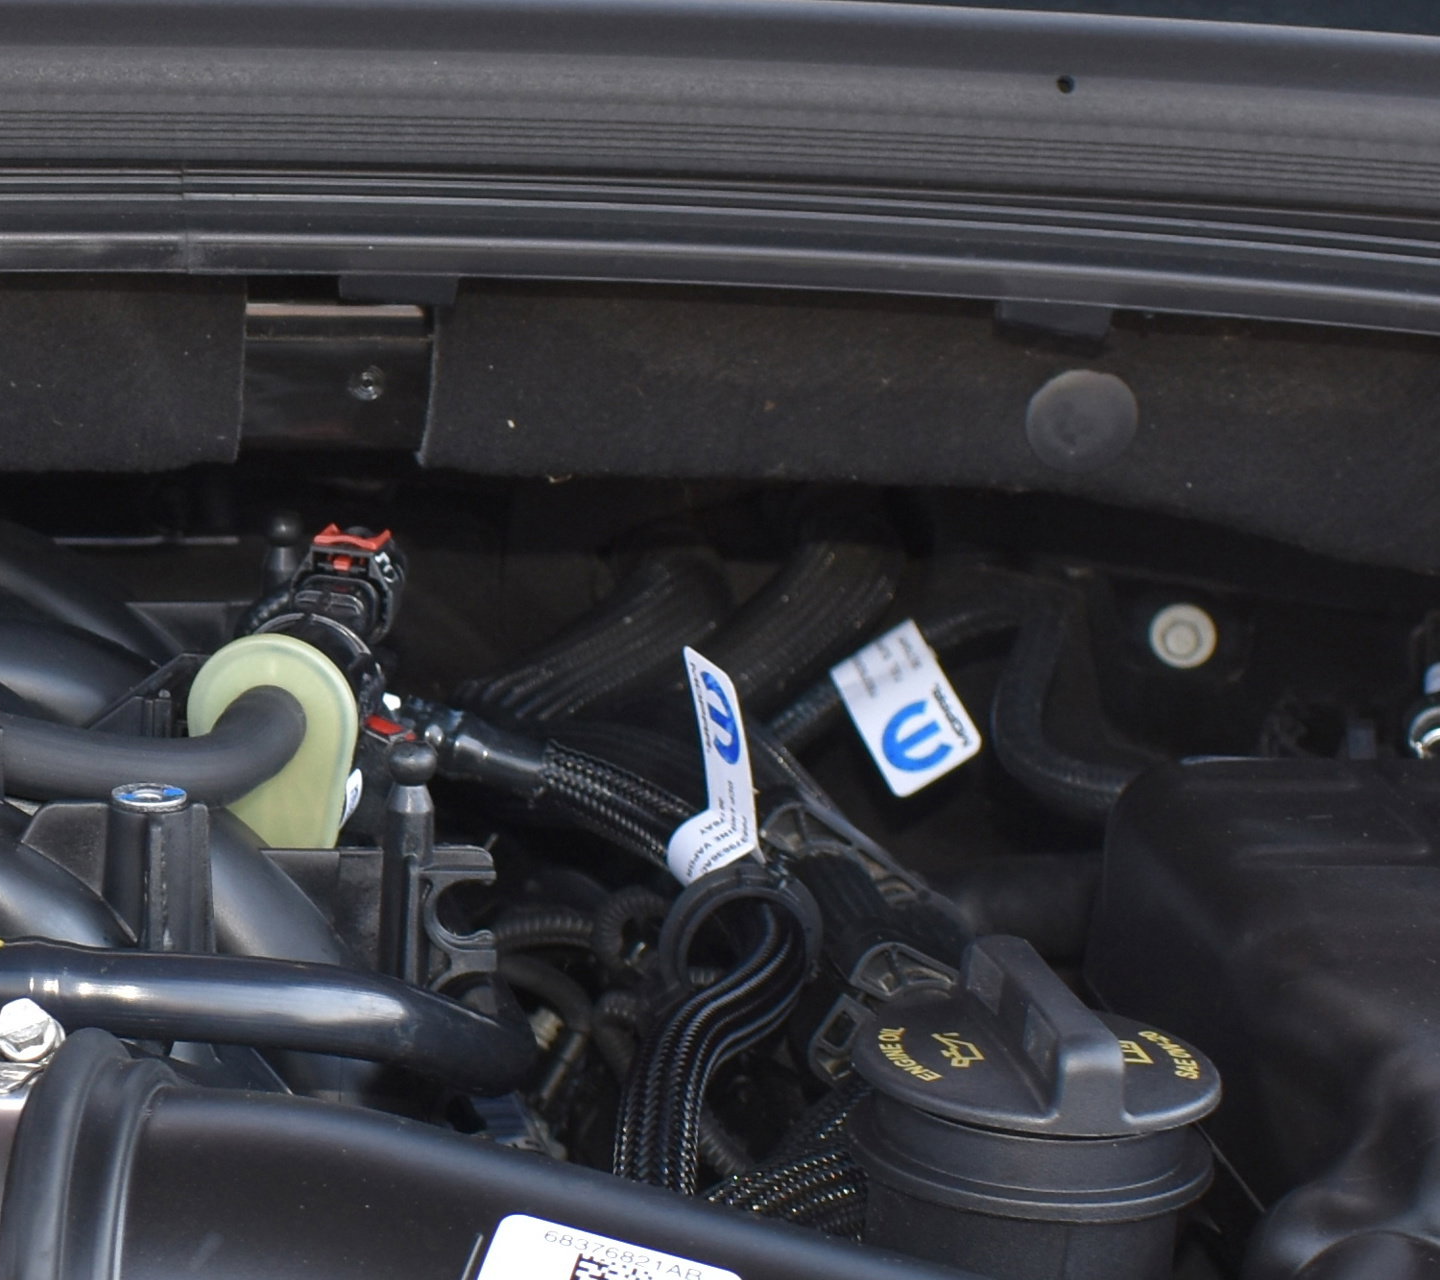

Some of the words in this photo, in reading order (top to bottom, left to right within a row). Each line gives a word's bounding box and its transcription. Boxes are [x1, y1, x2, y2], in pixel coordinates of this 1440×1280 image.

[878, 1026, 906, 1041] OIL
[878, 1043, 943, 1081] ENGINE
[1174, 1058, 1200, 1080] SAE
